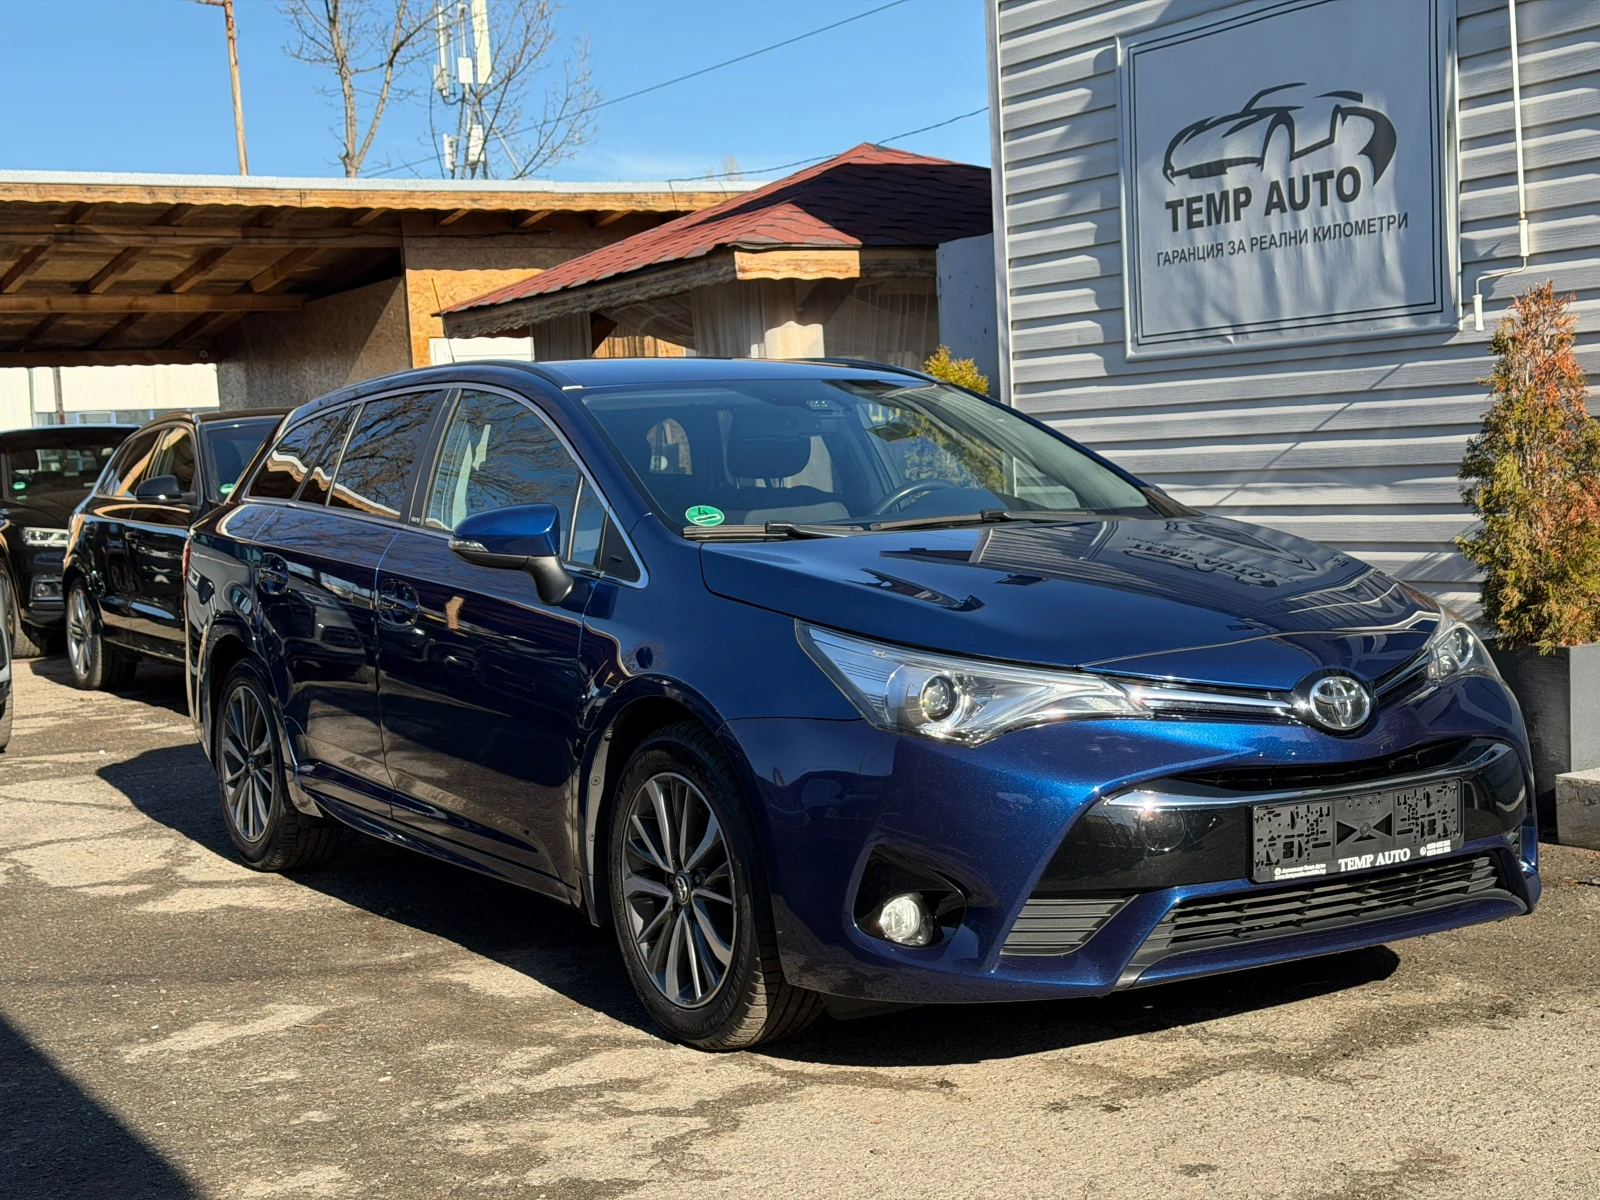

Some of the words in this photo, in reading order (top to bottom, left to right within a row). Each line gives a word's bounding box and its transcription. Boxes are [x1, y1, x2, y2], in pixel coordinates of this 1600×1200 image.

[1165, 186, 1252, 232] TEMP
[1264, 166, 1362, 217] AUTO
[1156, 242, 1224, 267] ГАРАНЦИЯ
[1228, 239, 1247, 255] ЗА
[1250, 228, 1308, 252] РЕАЛНИ
[1313, 212, 1409, 243] КИЛОМЕТРИ
[1338, 853, 1374, 872] TEMP
[1375, 847, 1411, 866] AUTO
